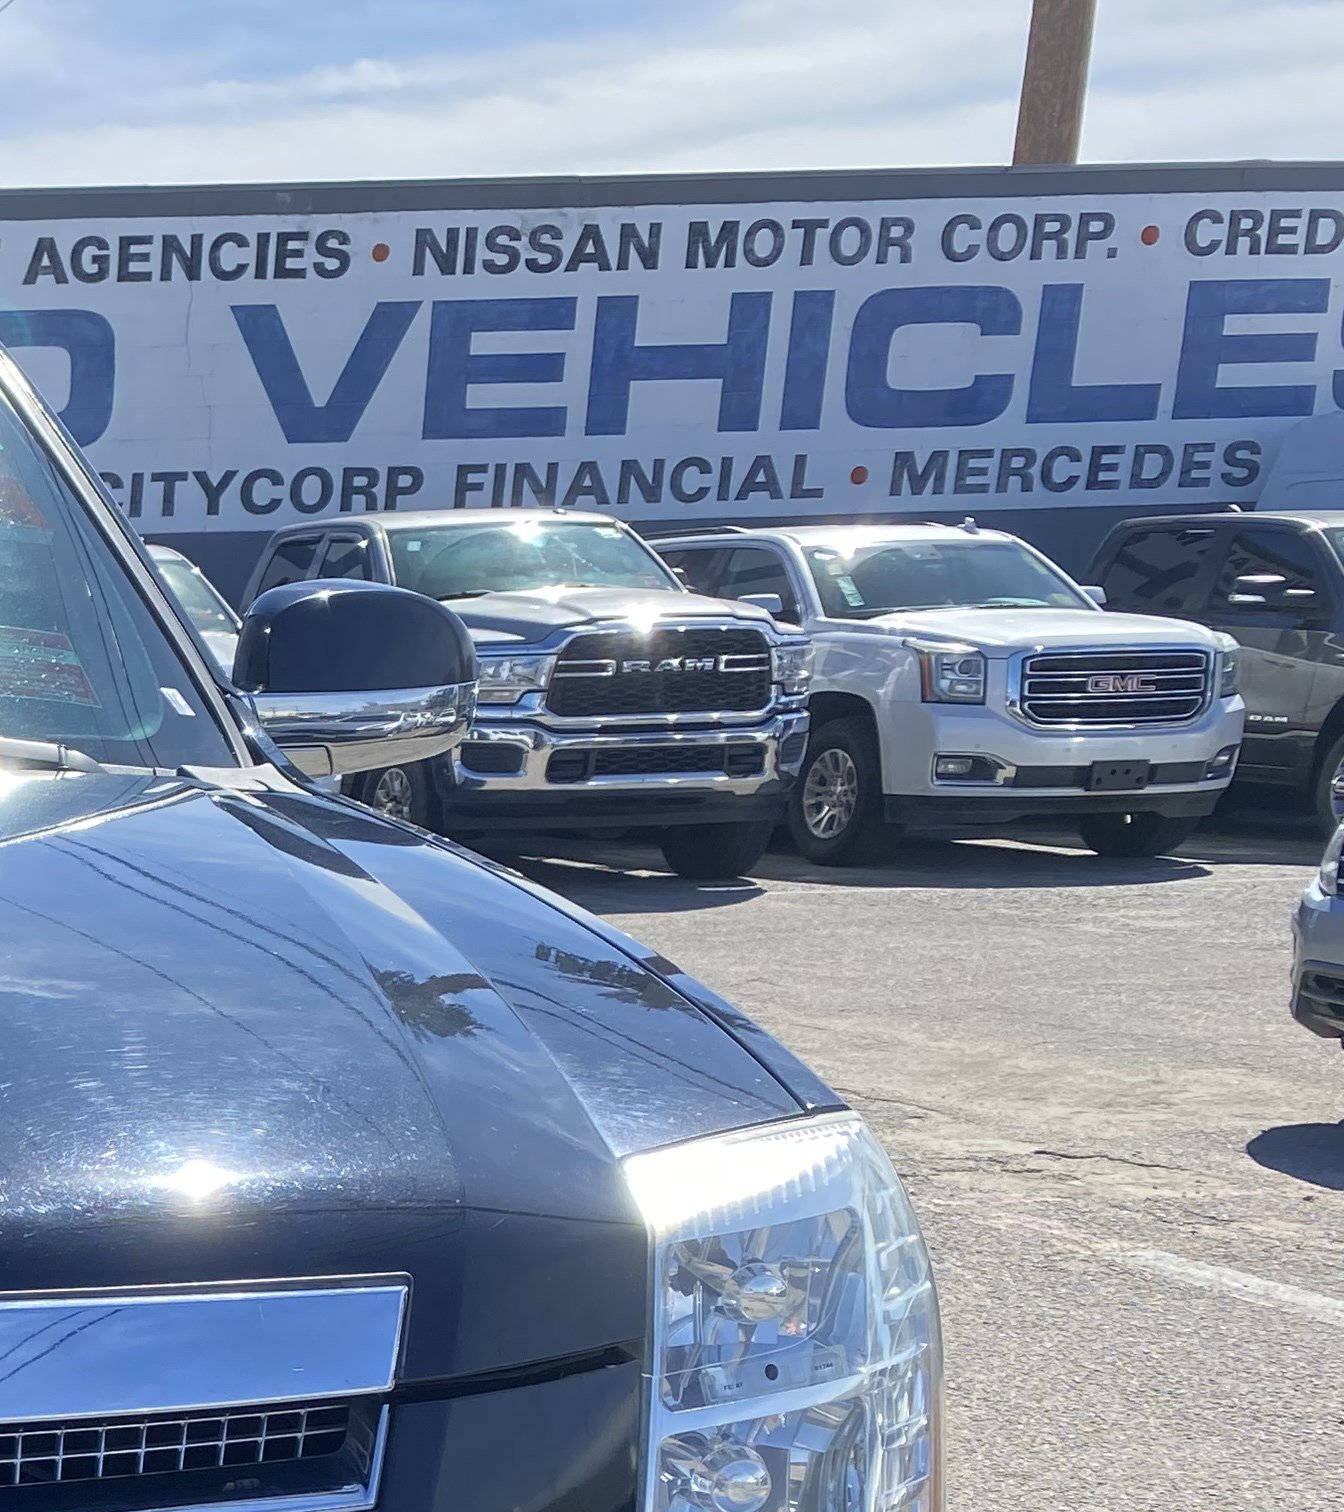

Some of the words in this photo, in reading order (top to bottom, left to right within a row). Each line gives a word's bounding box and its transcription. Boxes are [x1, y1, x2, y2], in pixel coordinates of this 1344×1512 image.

[23, 229, 351, 286] AGENCIES
[412, 221, 664, 277] NISSAN
[685, 217, 915, 272] MOTOR
[941, 211, 1119, 263] CORP.
[1184, 207, 1344, 258] CRED
[229, 277, 1344, 443] VEHICLE
[454, 453, 825, 509] FINANCIAL
[889, 440, 1262, 497] MERCEDES
[622, 656, 716, 673] RAM
[1086, 674, 1157, 692] GMC
